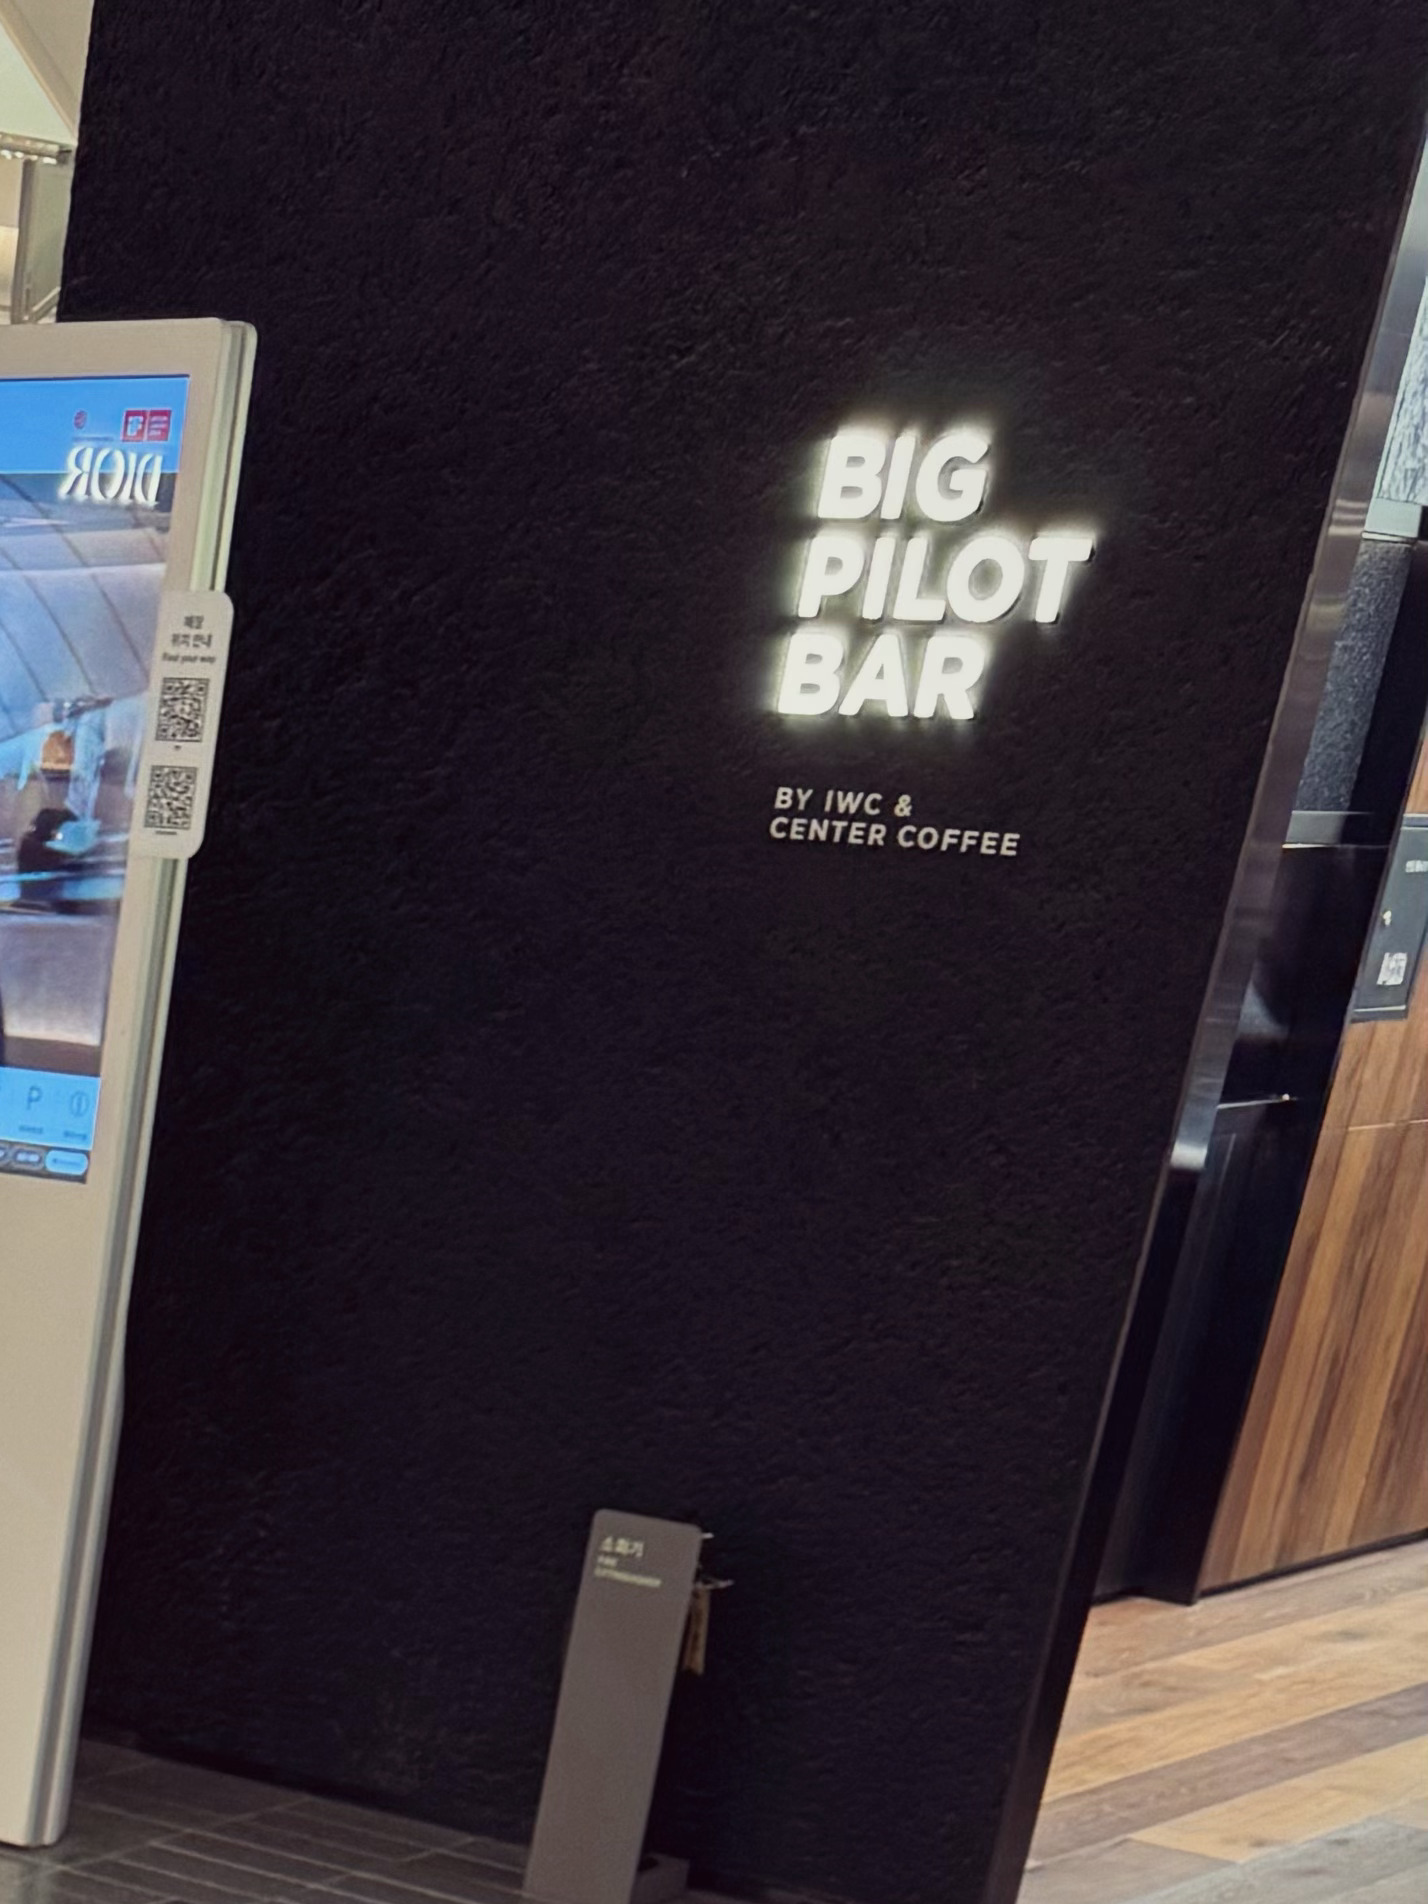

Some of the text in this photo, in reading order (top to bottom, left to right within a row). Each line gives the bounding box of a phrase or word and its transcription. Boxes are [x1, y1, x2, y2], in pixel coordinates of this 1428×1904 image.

[817, 431, 992, 522] BIG
[797, 534, 1097, 624] PILOT
[777, 632, 986, 720] BAR
[769, 816, 1021, 857] CENTER COFFEE
[774, 787, 913, 817] BY IWC &
